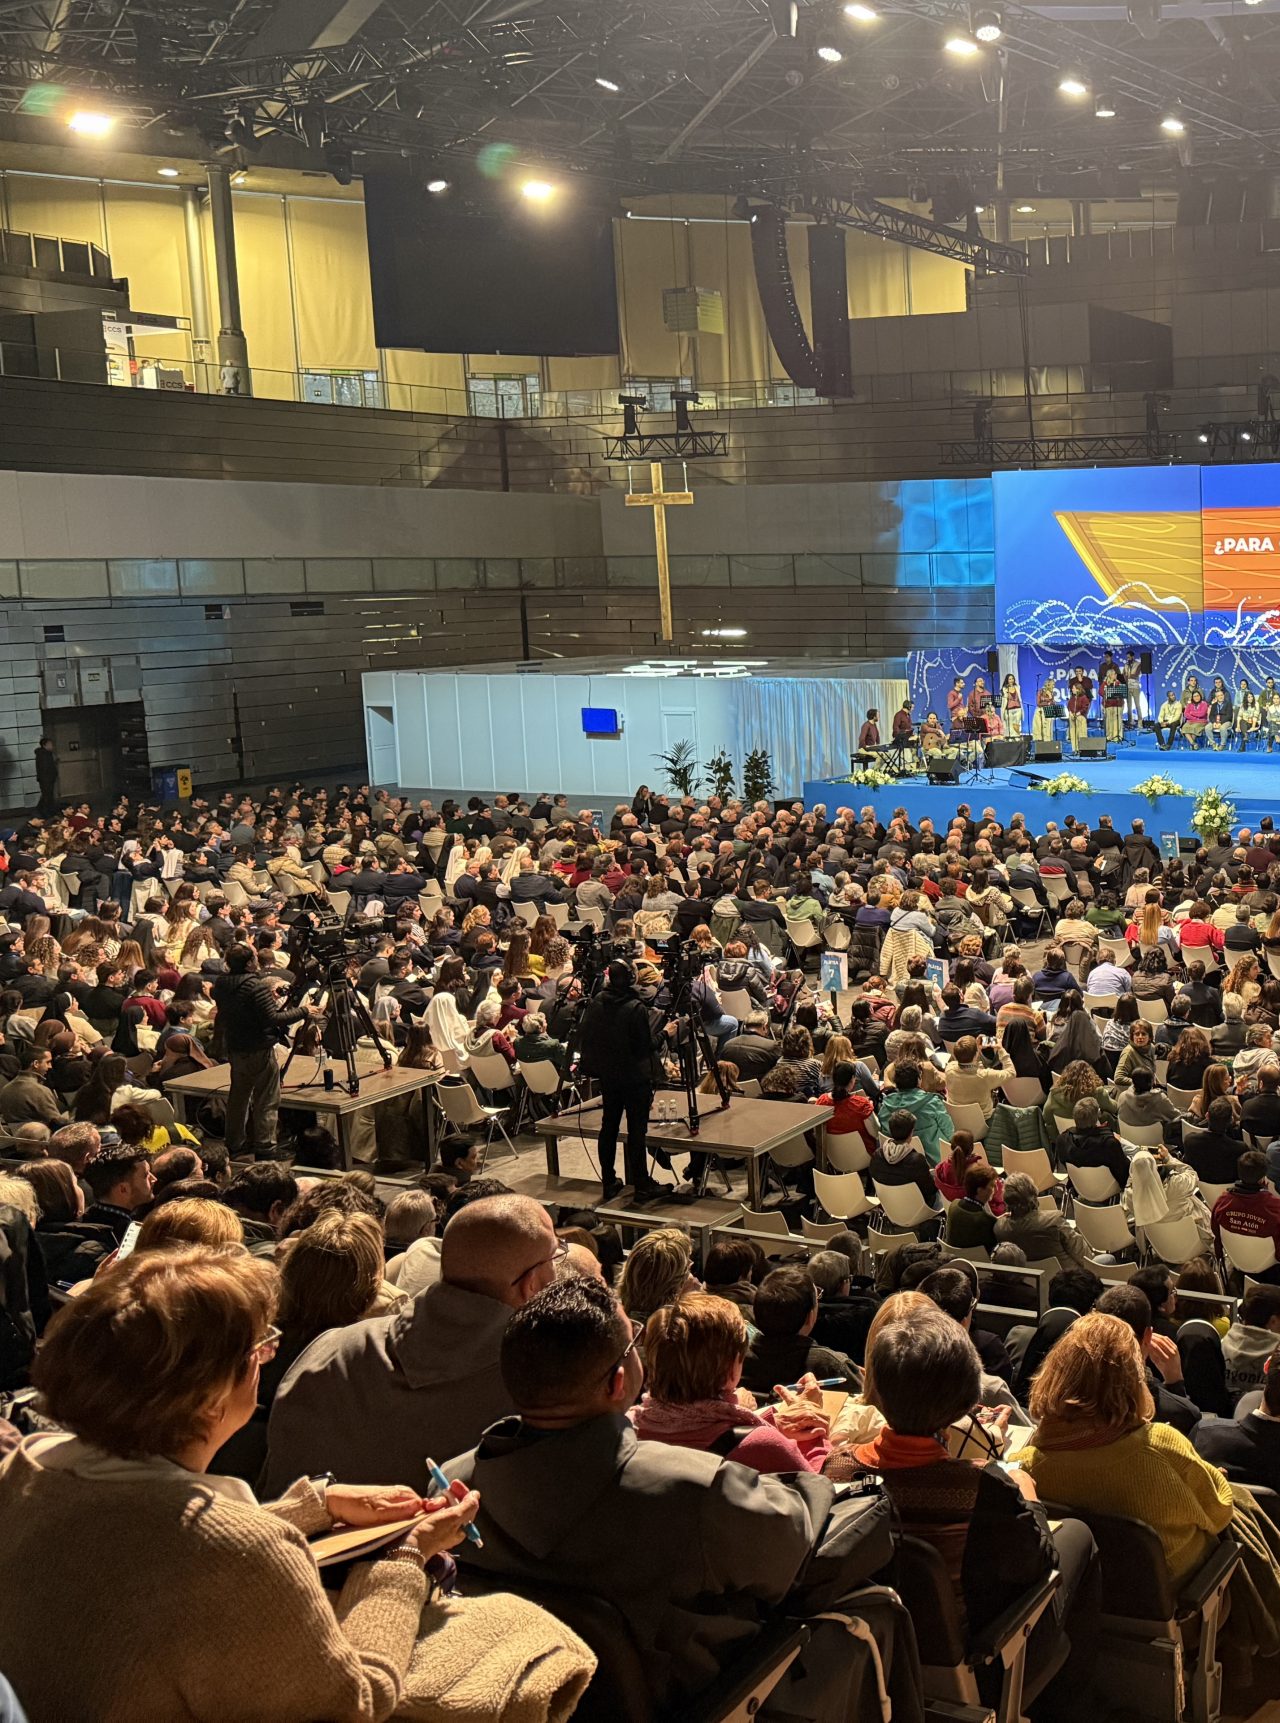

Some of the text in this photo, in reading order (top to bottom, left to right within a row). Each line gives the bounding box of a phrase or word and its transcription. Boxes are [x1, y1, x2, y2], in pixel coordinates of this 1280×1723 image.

[166, 381, 183, 389] CCS
[1214, 536, 1274, 555] ¿PARA
[1049, 668, 1098, 682] ¿PAA
[829, 969, 835, 978] 7
[932, 973, 938, 982] 6
[1229, 1217, 1242, 1226] San
[1246, 1213, 1266, 1225] JOVEN
